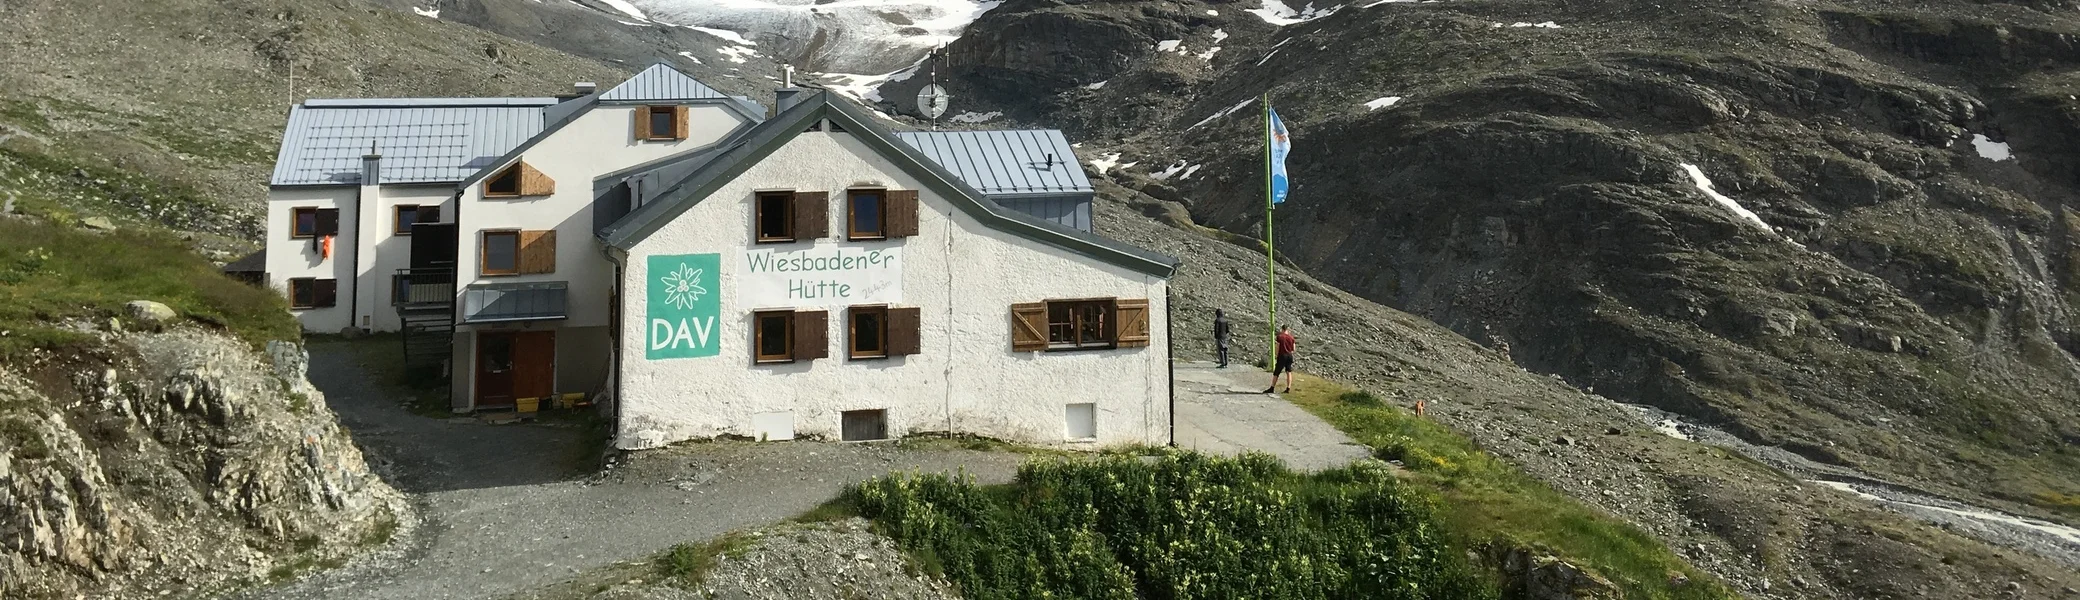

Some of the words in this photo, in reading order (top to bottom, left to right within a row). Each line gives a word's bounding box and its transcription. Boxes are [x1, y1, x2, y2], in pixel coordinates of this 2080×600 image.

[747, 250, 895, 273] Wiesbadener
[788, 279, 851, 299] Hütte
[651, 315, 715, 351] DAV
